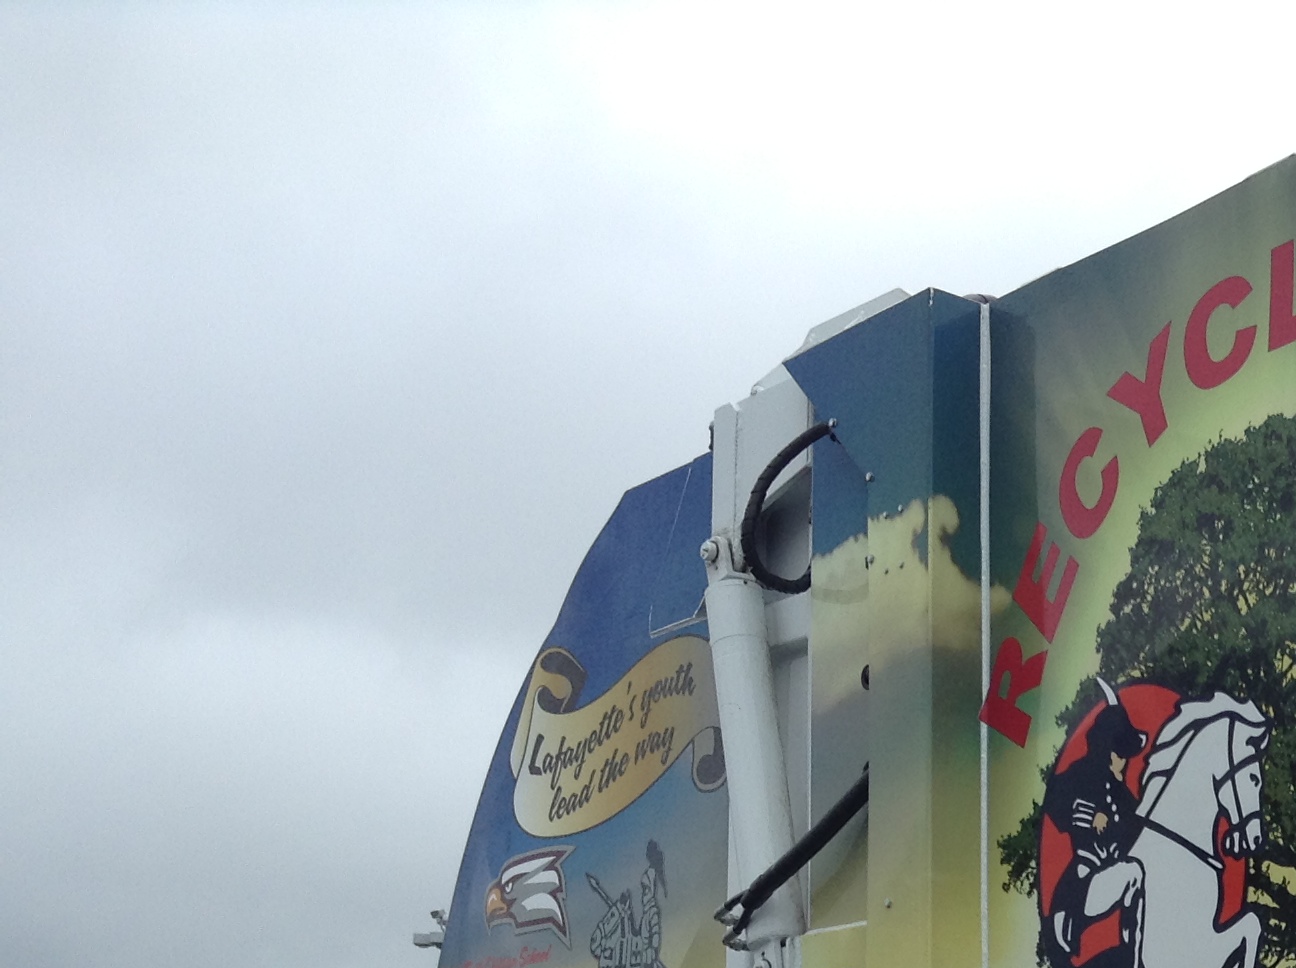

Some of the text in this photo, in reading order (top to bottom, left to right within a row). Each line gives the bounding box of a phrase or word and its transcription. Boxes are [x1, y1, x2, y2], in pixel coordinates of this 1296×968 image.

[528, 661, 696, 790] Lafayette's youth
[549, 726, 675, 822] lead the way
